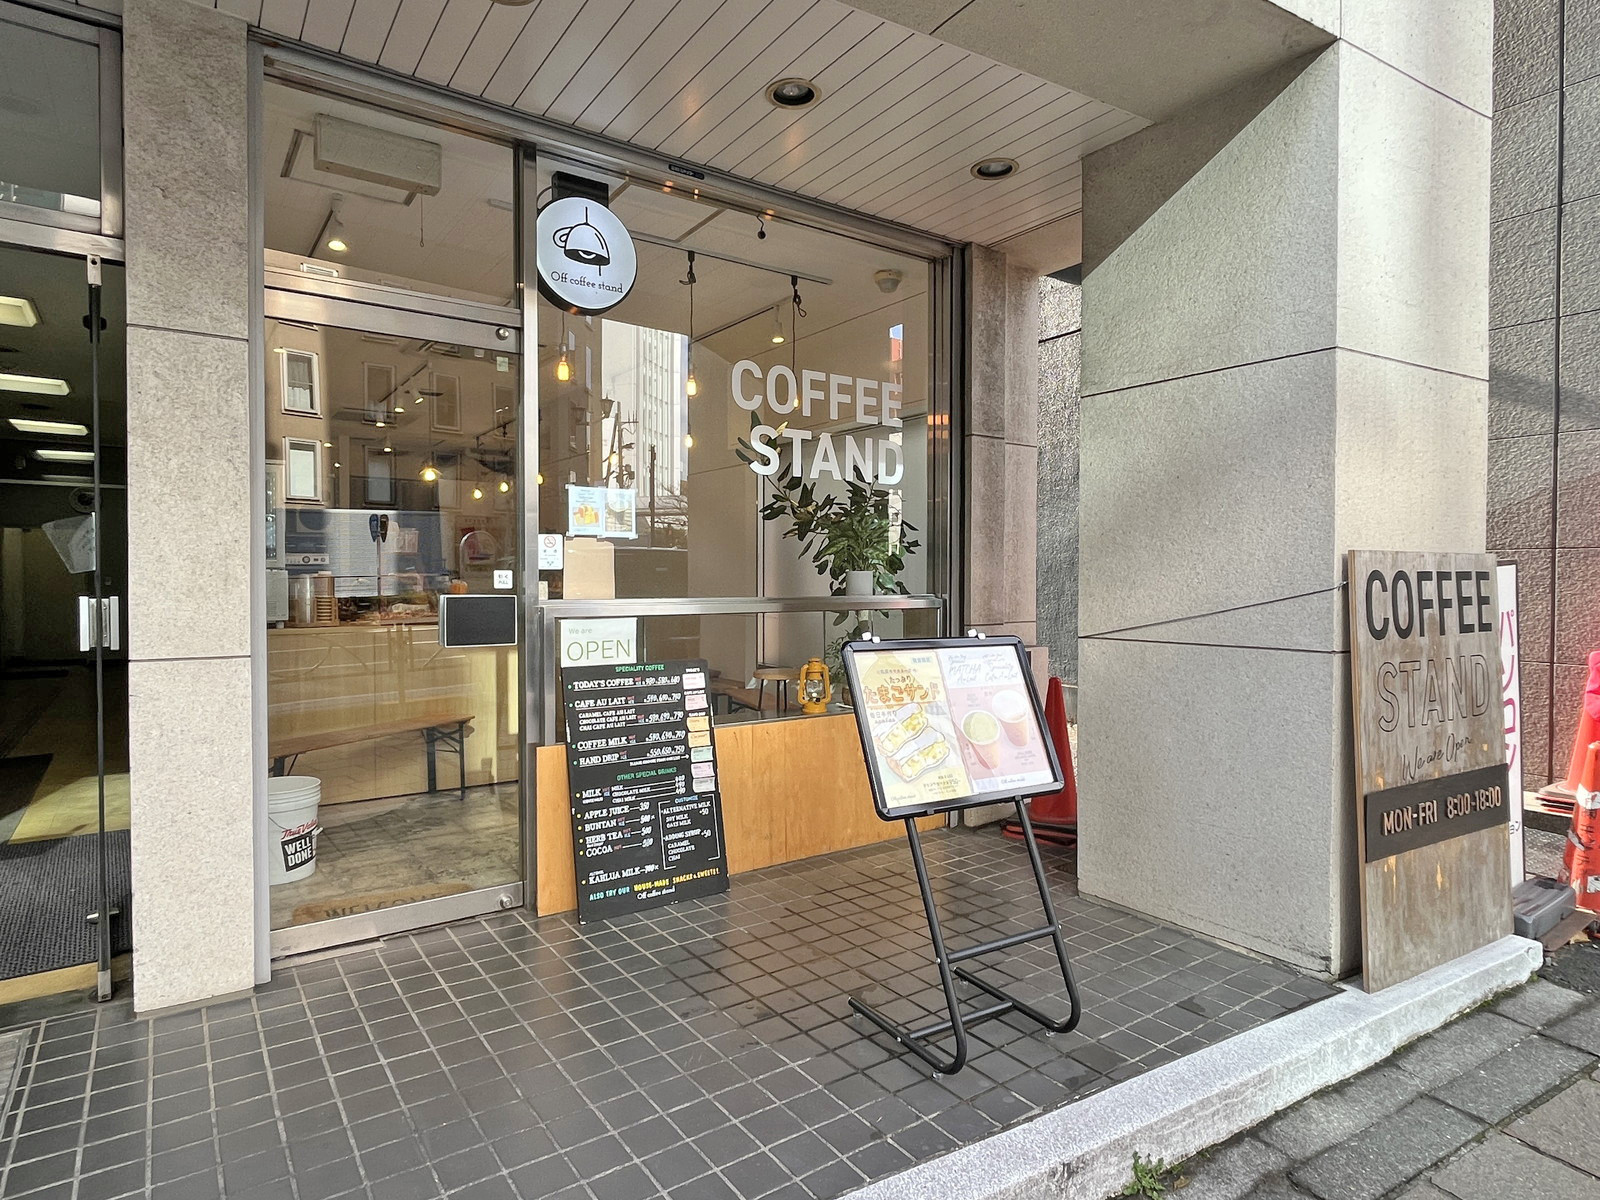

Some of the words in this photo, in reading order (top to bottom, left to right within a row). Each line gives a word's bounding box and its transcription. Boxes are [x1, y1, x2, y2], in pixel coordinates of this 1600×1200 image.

[550, 271, 569, 283] Off
[569, 276, 597, 289] coffee
[597, 283, 624, 294] stand
[731, 358, 903, 428] COFFEE
[749, 424, 905, 486] STAND
[1365, 569, 1493, 641] COFFEE
[568, 627, 580, 635] We
[566, 639, 631, 662] OPEN
[573, 681, 605, 690] TODAY'S
[606, 678, 634, 686] COFFEE
[1376, 654, 1490, 733] STAND
[574, 700, 595, 708] CAFE
[608, 697, 626, 705] LAIT
[577, 739, 607, 749] COFFEE
[608, 737, 628, 745] MILK
[579, 756, 602, 765] HAND
[602, 753, 620, 762] DRIP
[1402, 746, 1425, 781] We
[1426, 750, 1444, 764] are
[1446, 732, 1472, 763] Open
[617, 773, 635, 781] OTHER
[635, 770, 657, 778] SPECIAL
[582, 788, 602, 798] MILK
[584, 809, 608, 819] APPLE
[608, 805, 630, 817] JUICE
[663, 803, 697, 814] ALTERNATIVE
[1382, 800, 1438, 836] MON-FRI
[1446, 785, 1502, 819] 8:00-18:00
[584, 819, 617, 832] BUNTAN
[585, 834, 606, 844] HERB
[607, 831, 623, 840] TEA
[284, 836, 312, 855] WELL
[586, 845, 613, 857] COCOA
[668, 840, 690, 849] CARAMEL
[668, 845, 695, 855] CHOCOLATE
[288, 846, 312, 867] DONE
[589, 871, 621, 884] KAHLUA
[622, 867, 641, 877] MILK
[589, 891, 604, 901] ALSO
[606, 888, 617, 897] TRY
[618, 886, 631, 894] OUR
